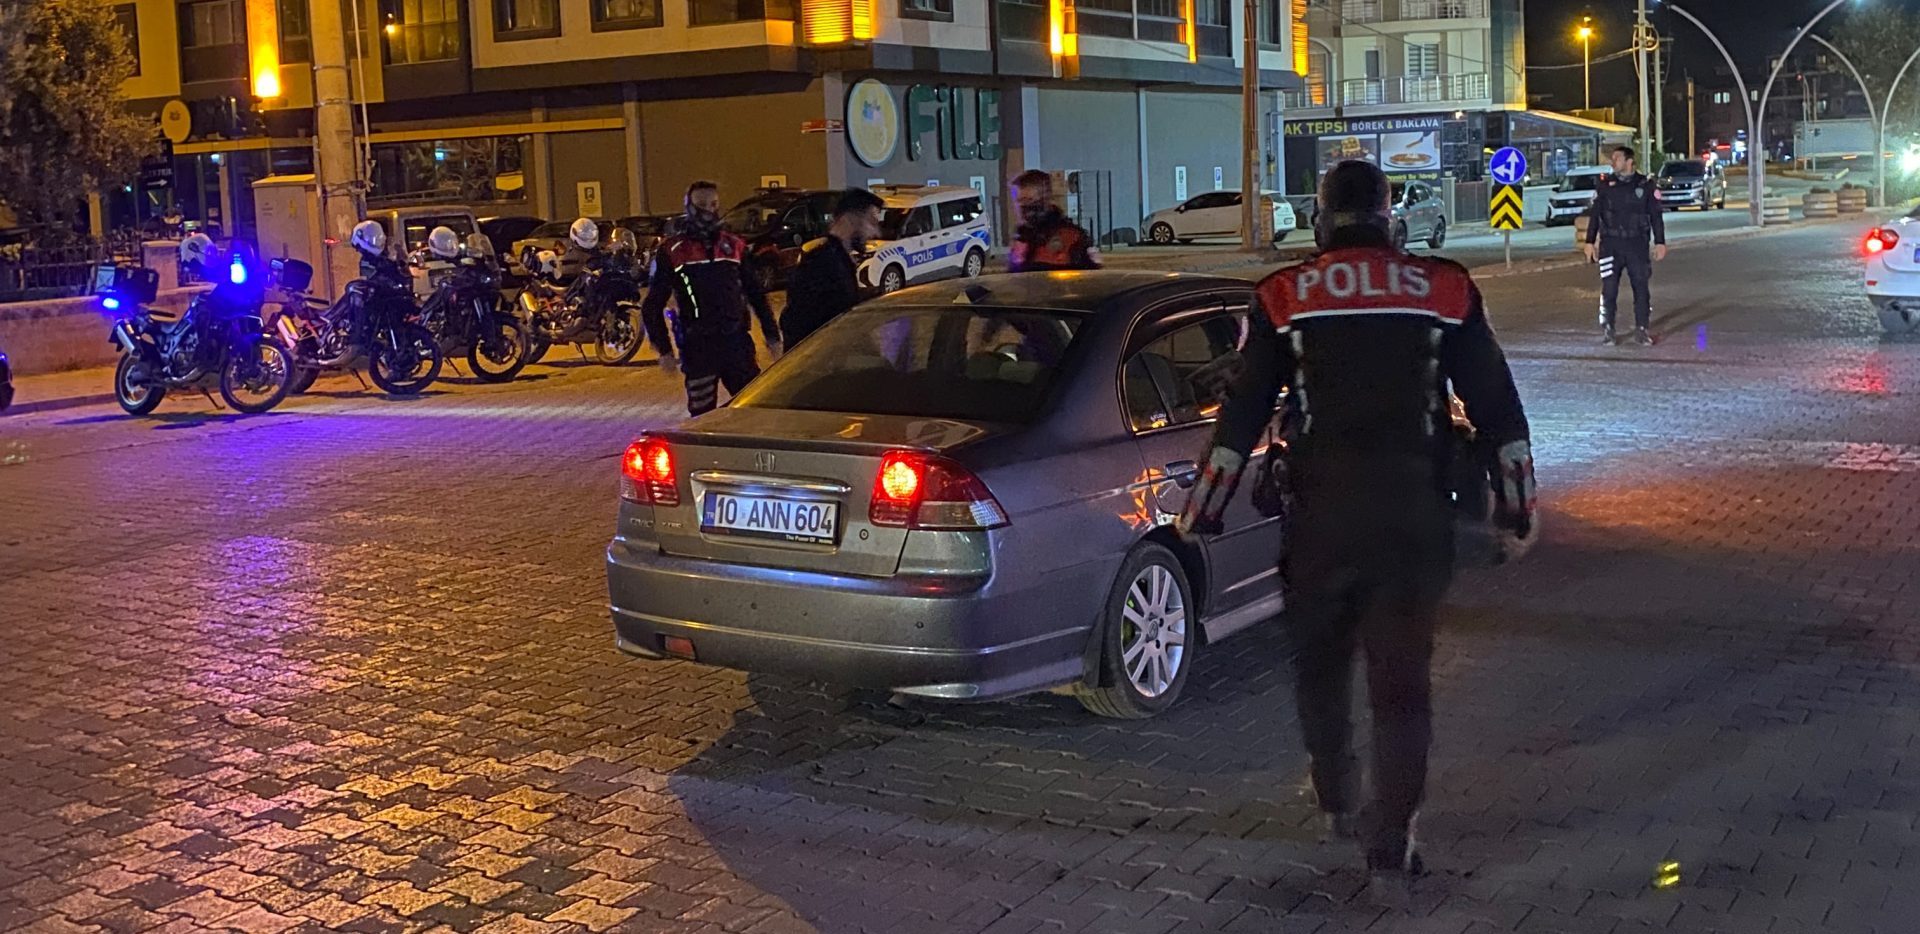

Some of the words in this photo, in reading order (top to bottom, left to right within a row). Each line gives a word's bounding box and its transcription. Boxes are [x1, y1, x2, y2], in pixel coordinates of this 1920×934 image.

[1387, 121, 1393, 129] &
[1396, 118, 1439, 129] BAKLAVA
[717, 497, 738, 525] 10
[747, 500, 791, 530] ANN
[794, 504, 832, 534] 604
